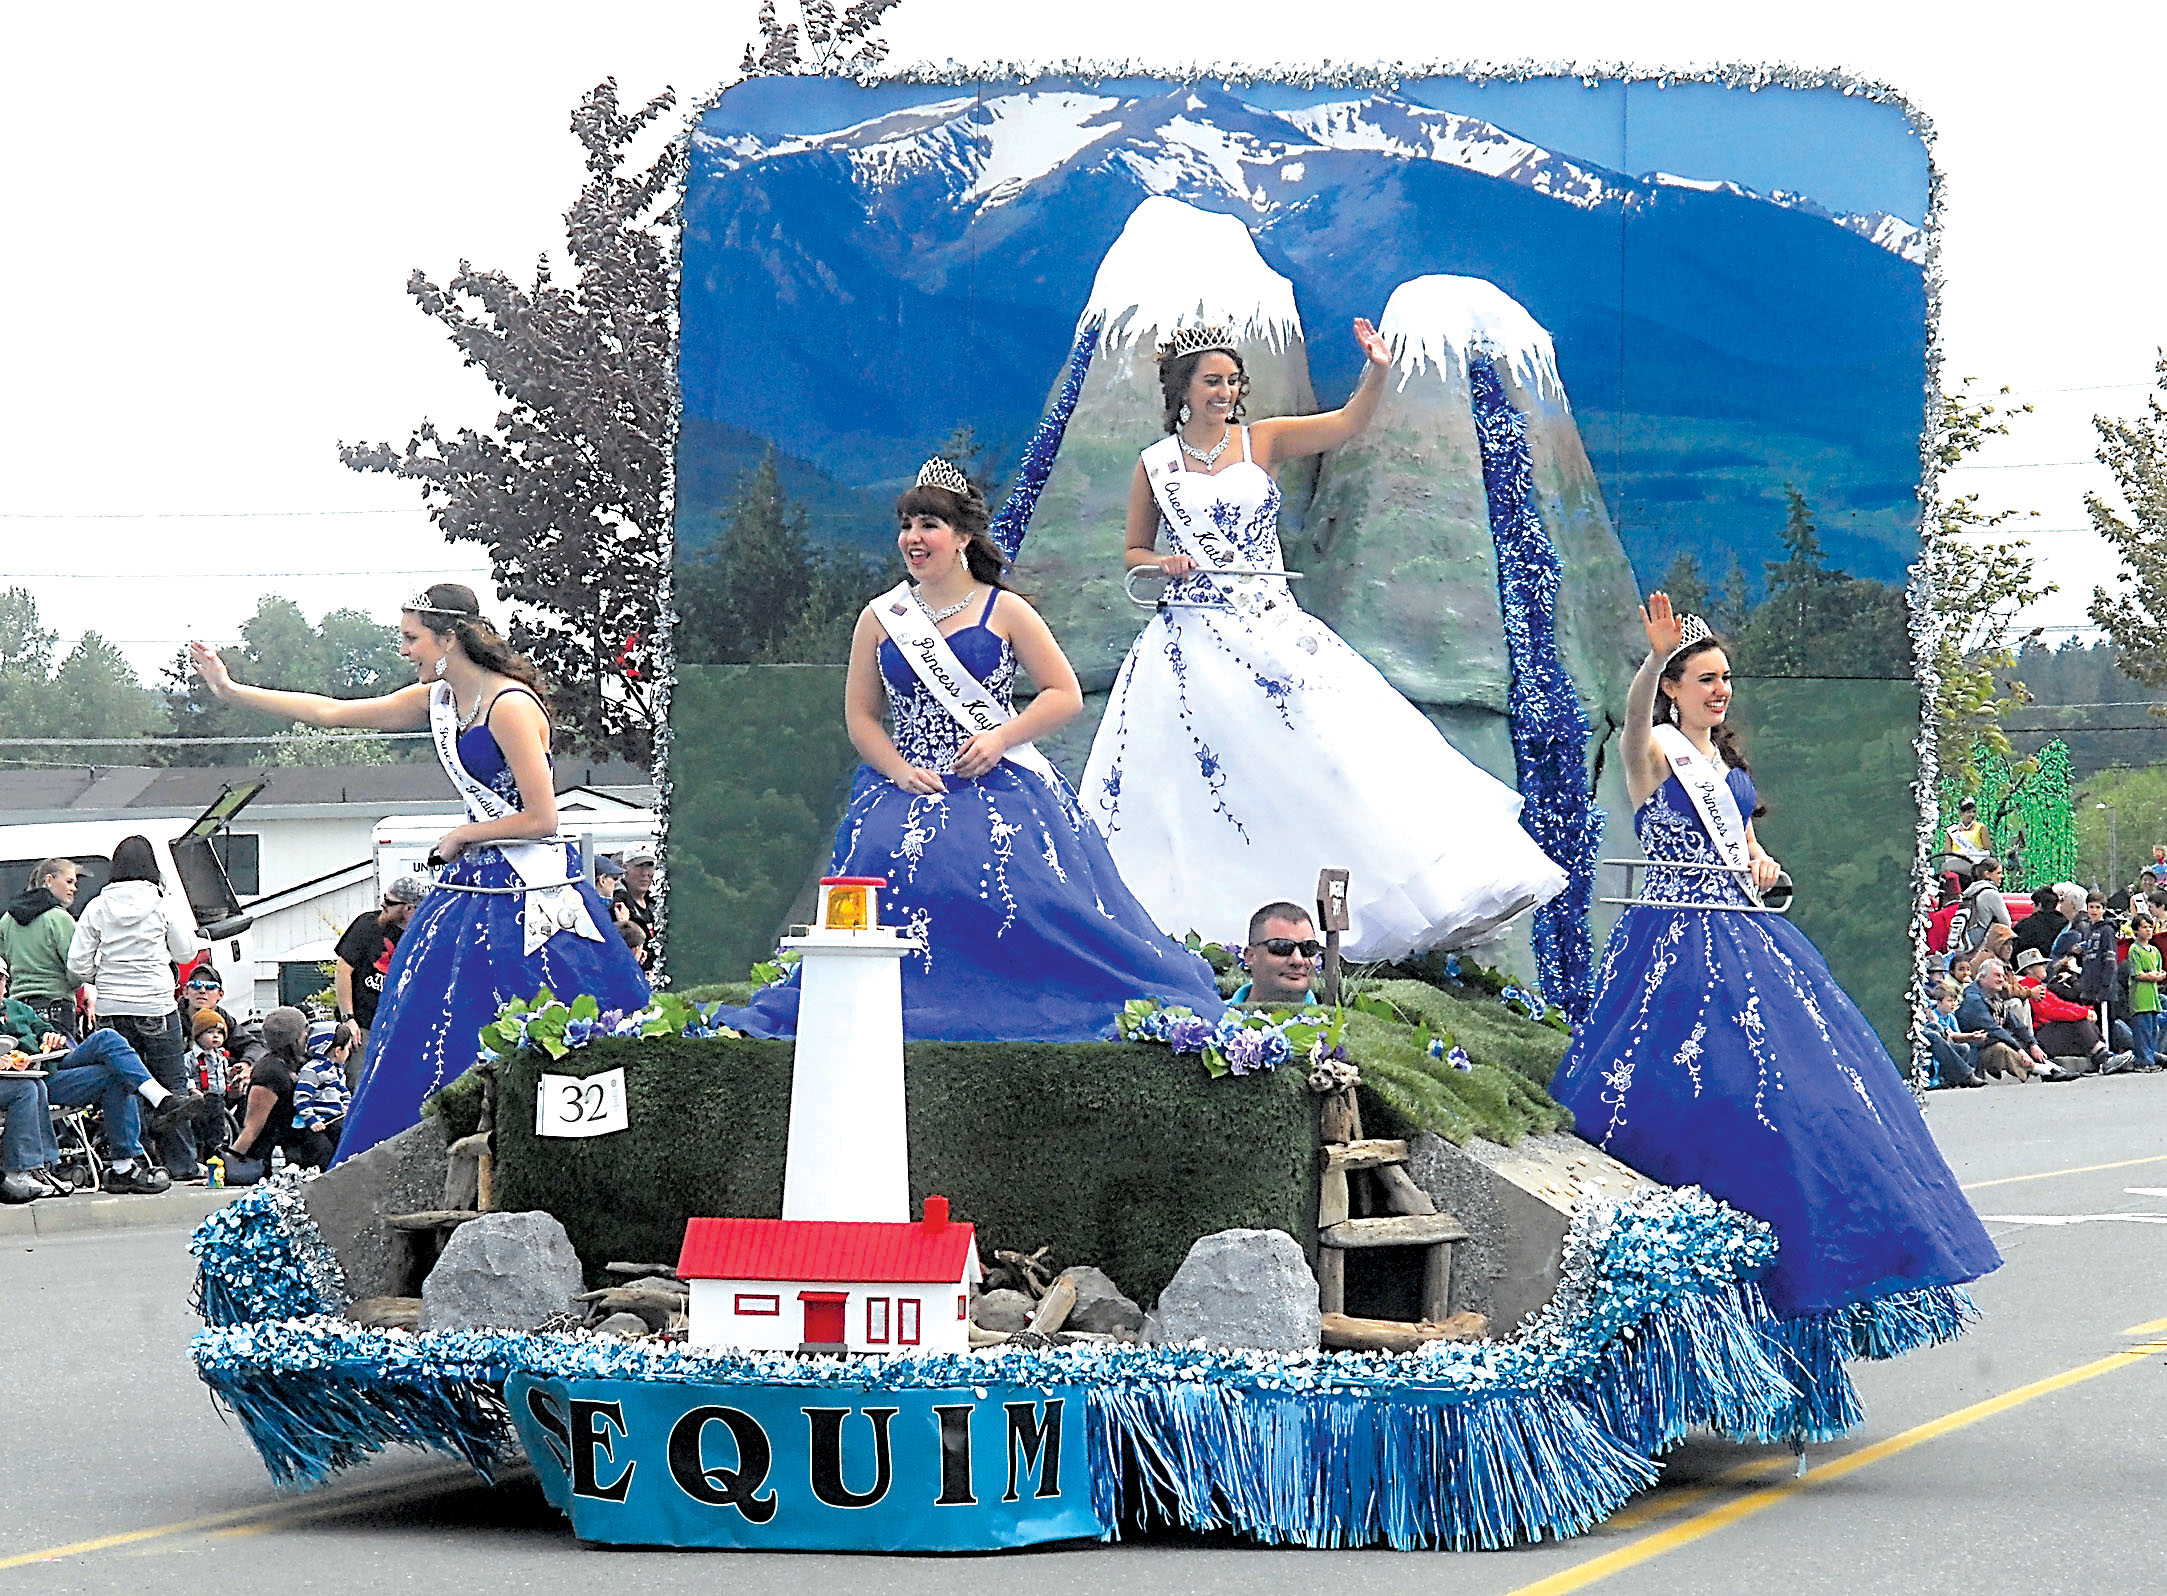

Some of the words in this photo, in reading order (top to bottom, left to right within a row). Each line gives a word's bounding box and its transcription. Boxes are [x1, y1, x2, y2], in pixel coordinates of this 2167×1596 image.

[1164, 481, 1192, 527] Queen
[1192, 531, 1227, 569] Kate
[911, 636, 960, 698] Princess
[439, 726, 465, 782] Princess
[465, 784, 504, 819] Judith
[1694, 780, 1728, 838] Princess
[412, 861, 447, 873] UNO
[559, 1083, 608, 1123] 32
[524, 1384, 1066, 1525] SEQUIM
